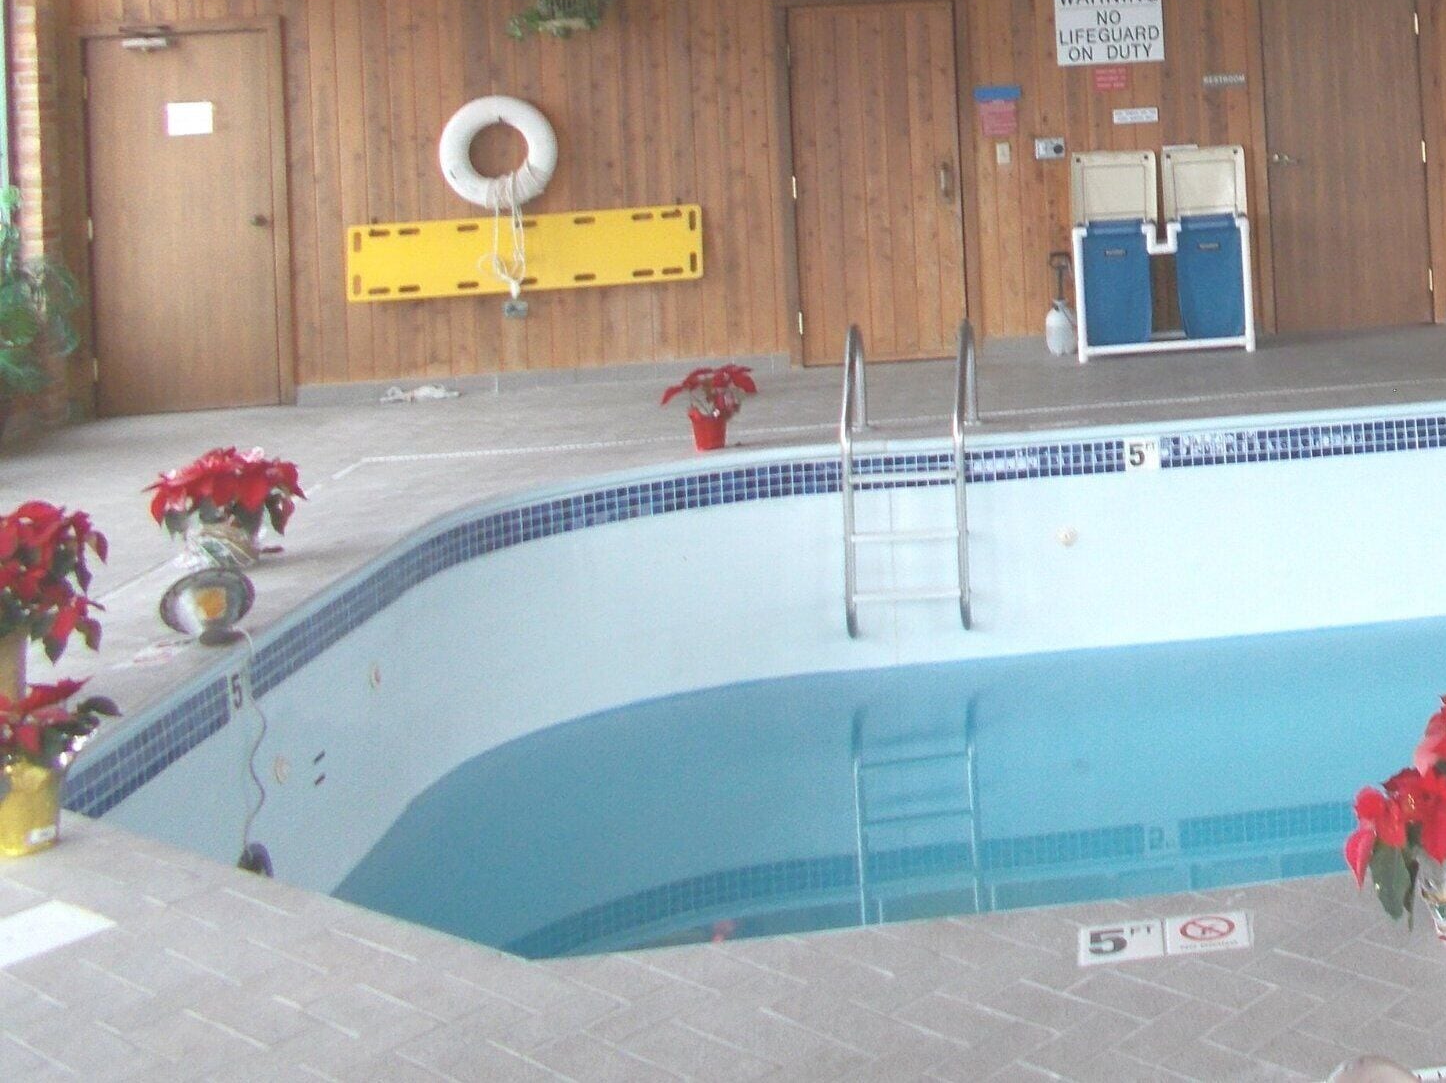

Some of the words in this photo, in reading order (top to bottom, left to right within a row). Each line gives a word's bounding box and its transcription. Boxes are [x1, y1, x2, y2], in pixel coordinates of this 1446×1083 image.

[1097, 10, 1121, 25] NO
[1060, 25, 1160, 46] LIFEGUARD
[1069, 45, 1093, 62] ON
[1107, 43, 1152, 60] DUTY
[1202, 73, 1246, 85] RESTROOM
[1129, 443, 1145, 466] 5
[231, 673, 243, 709] 5
[1088, 927, 1128, 955] 5
